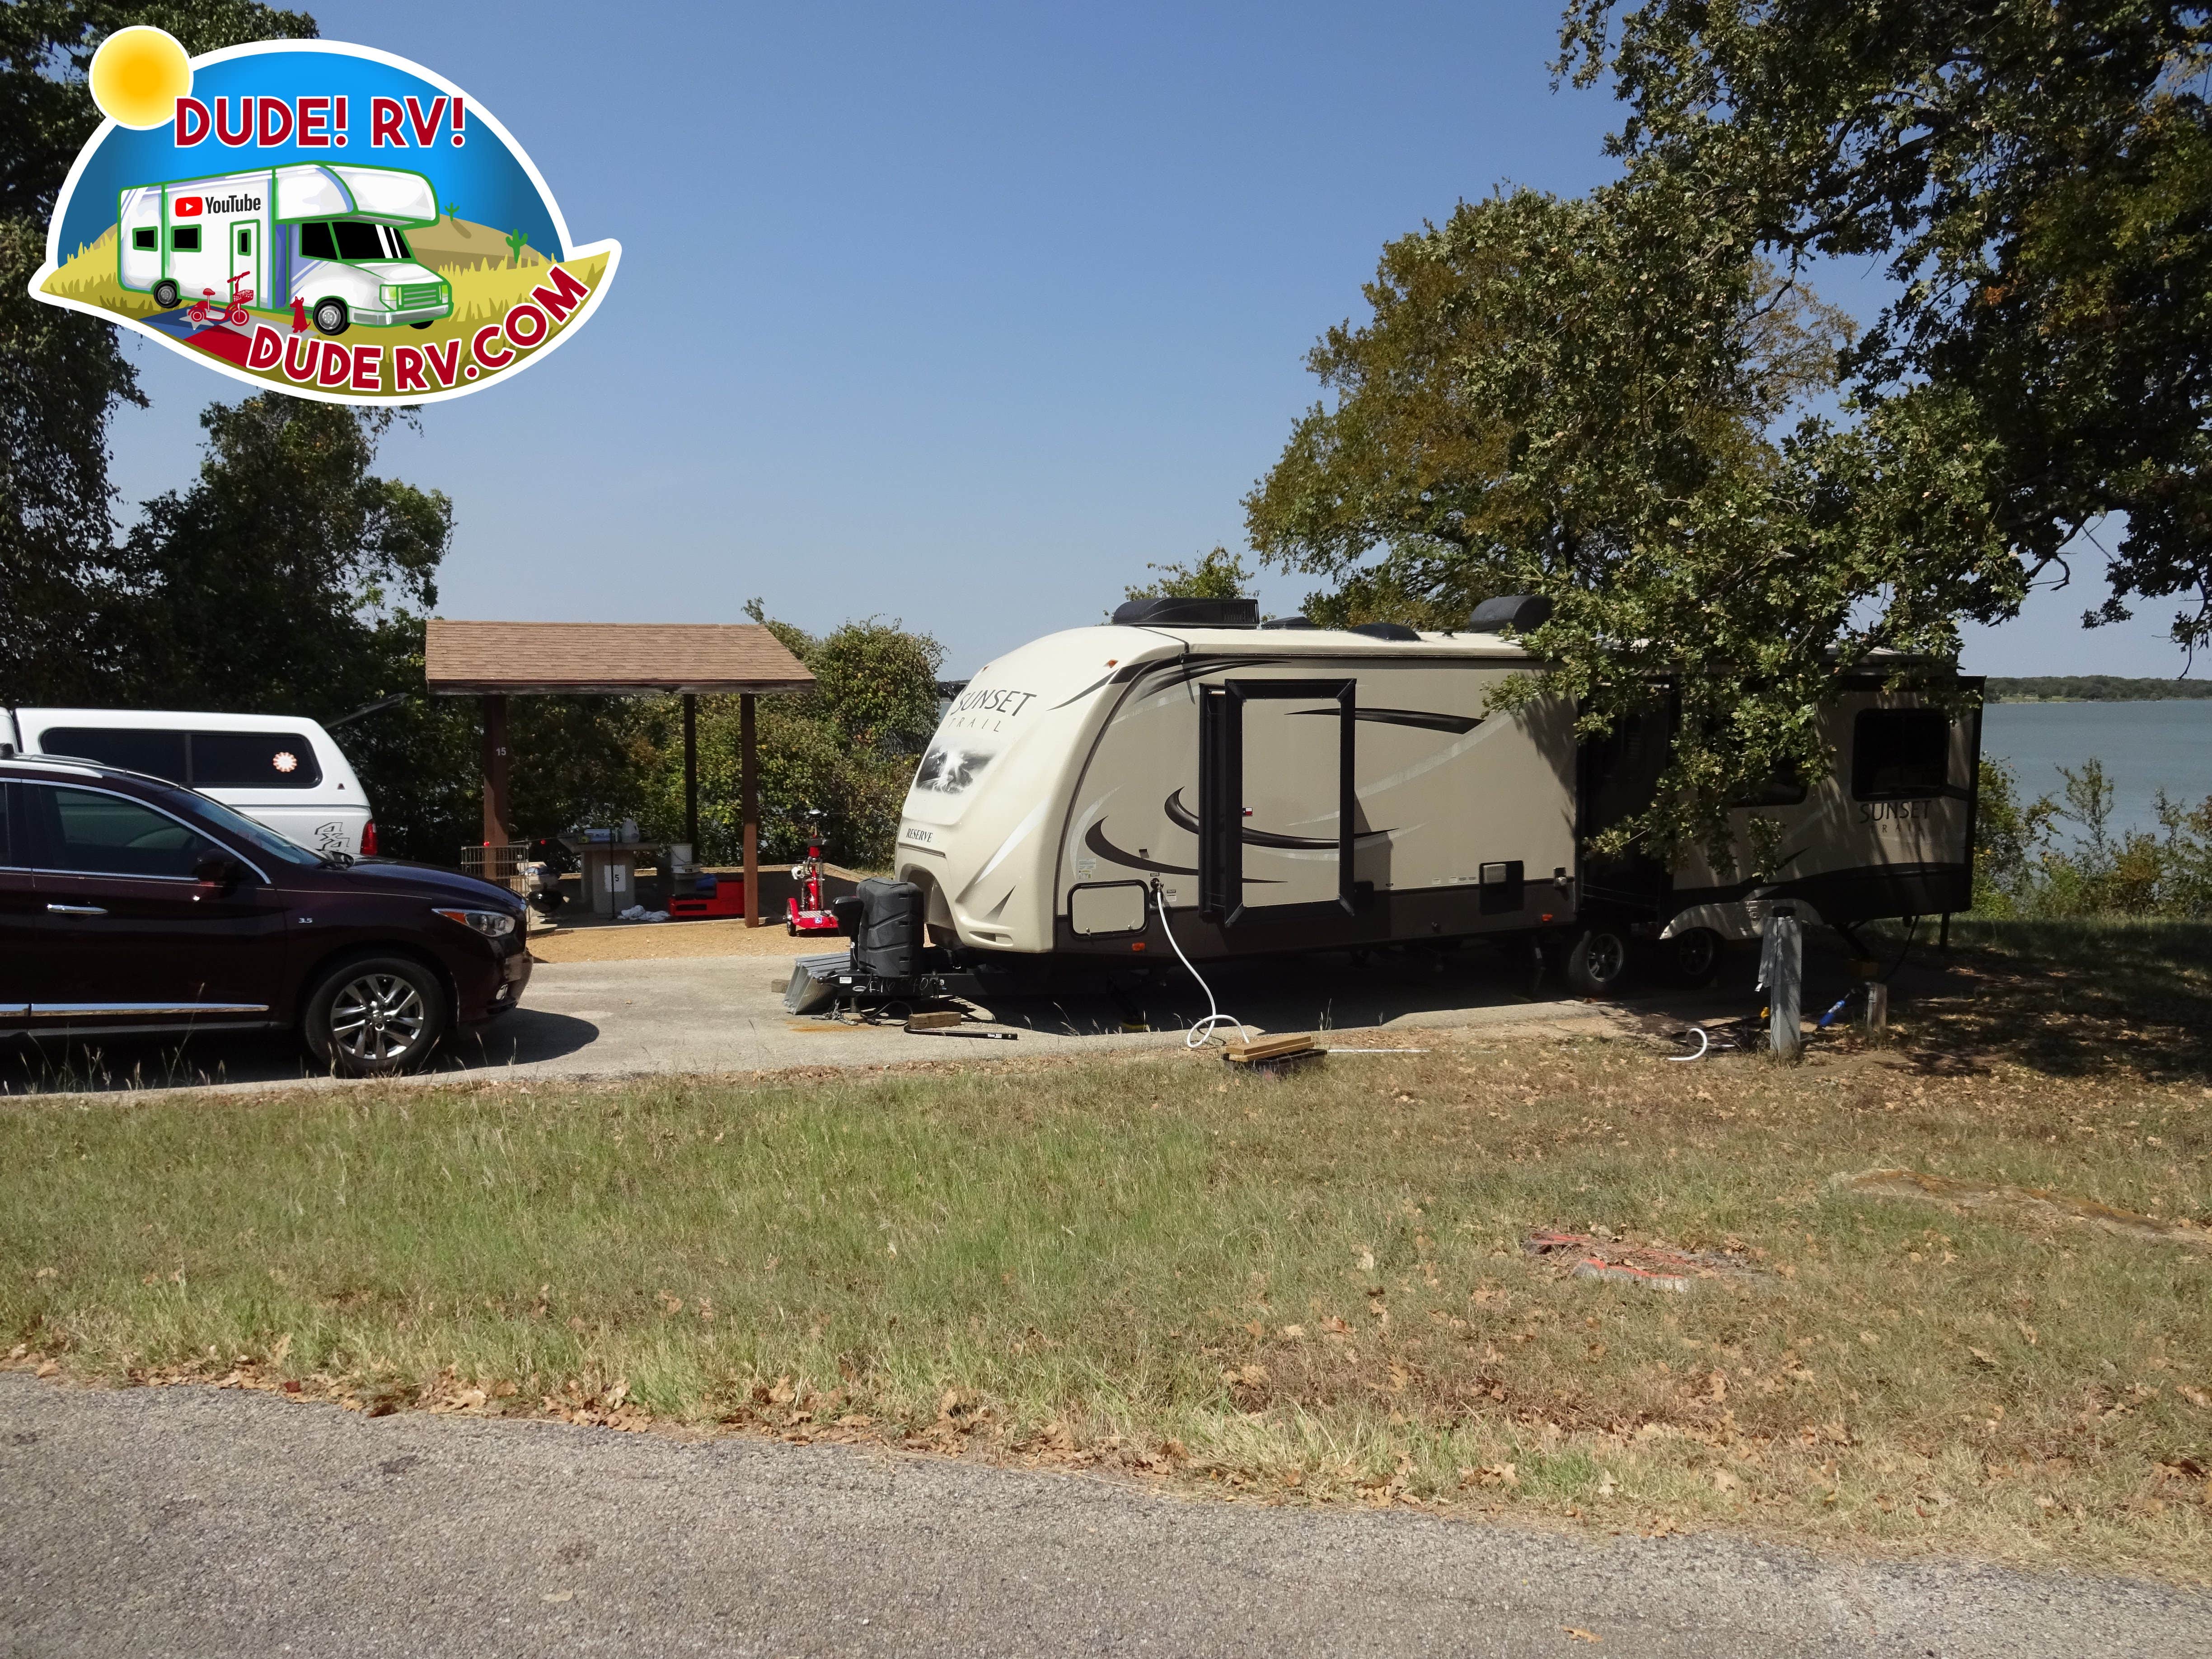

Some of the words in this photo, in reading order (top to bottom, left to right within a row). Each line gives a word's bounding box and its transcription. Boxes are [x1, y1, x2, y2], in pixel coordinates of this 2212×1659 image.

[950, 689, 1037, 716] SUNSET
[948, 717, 1001, 732] TRAIL
[496, 747, 506, 756] 15
[1860, 800, 1931, 823] SUNSET
[906, 828, 933, 843] RESERVE
